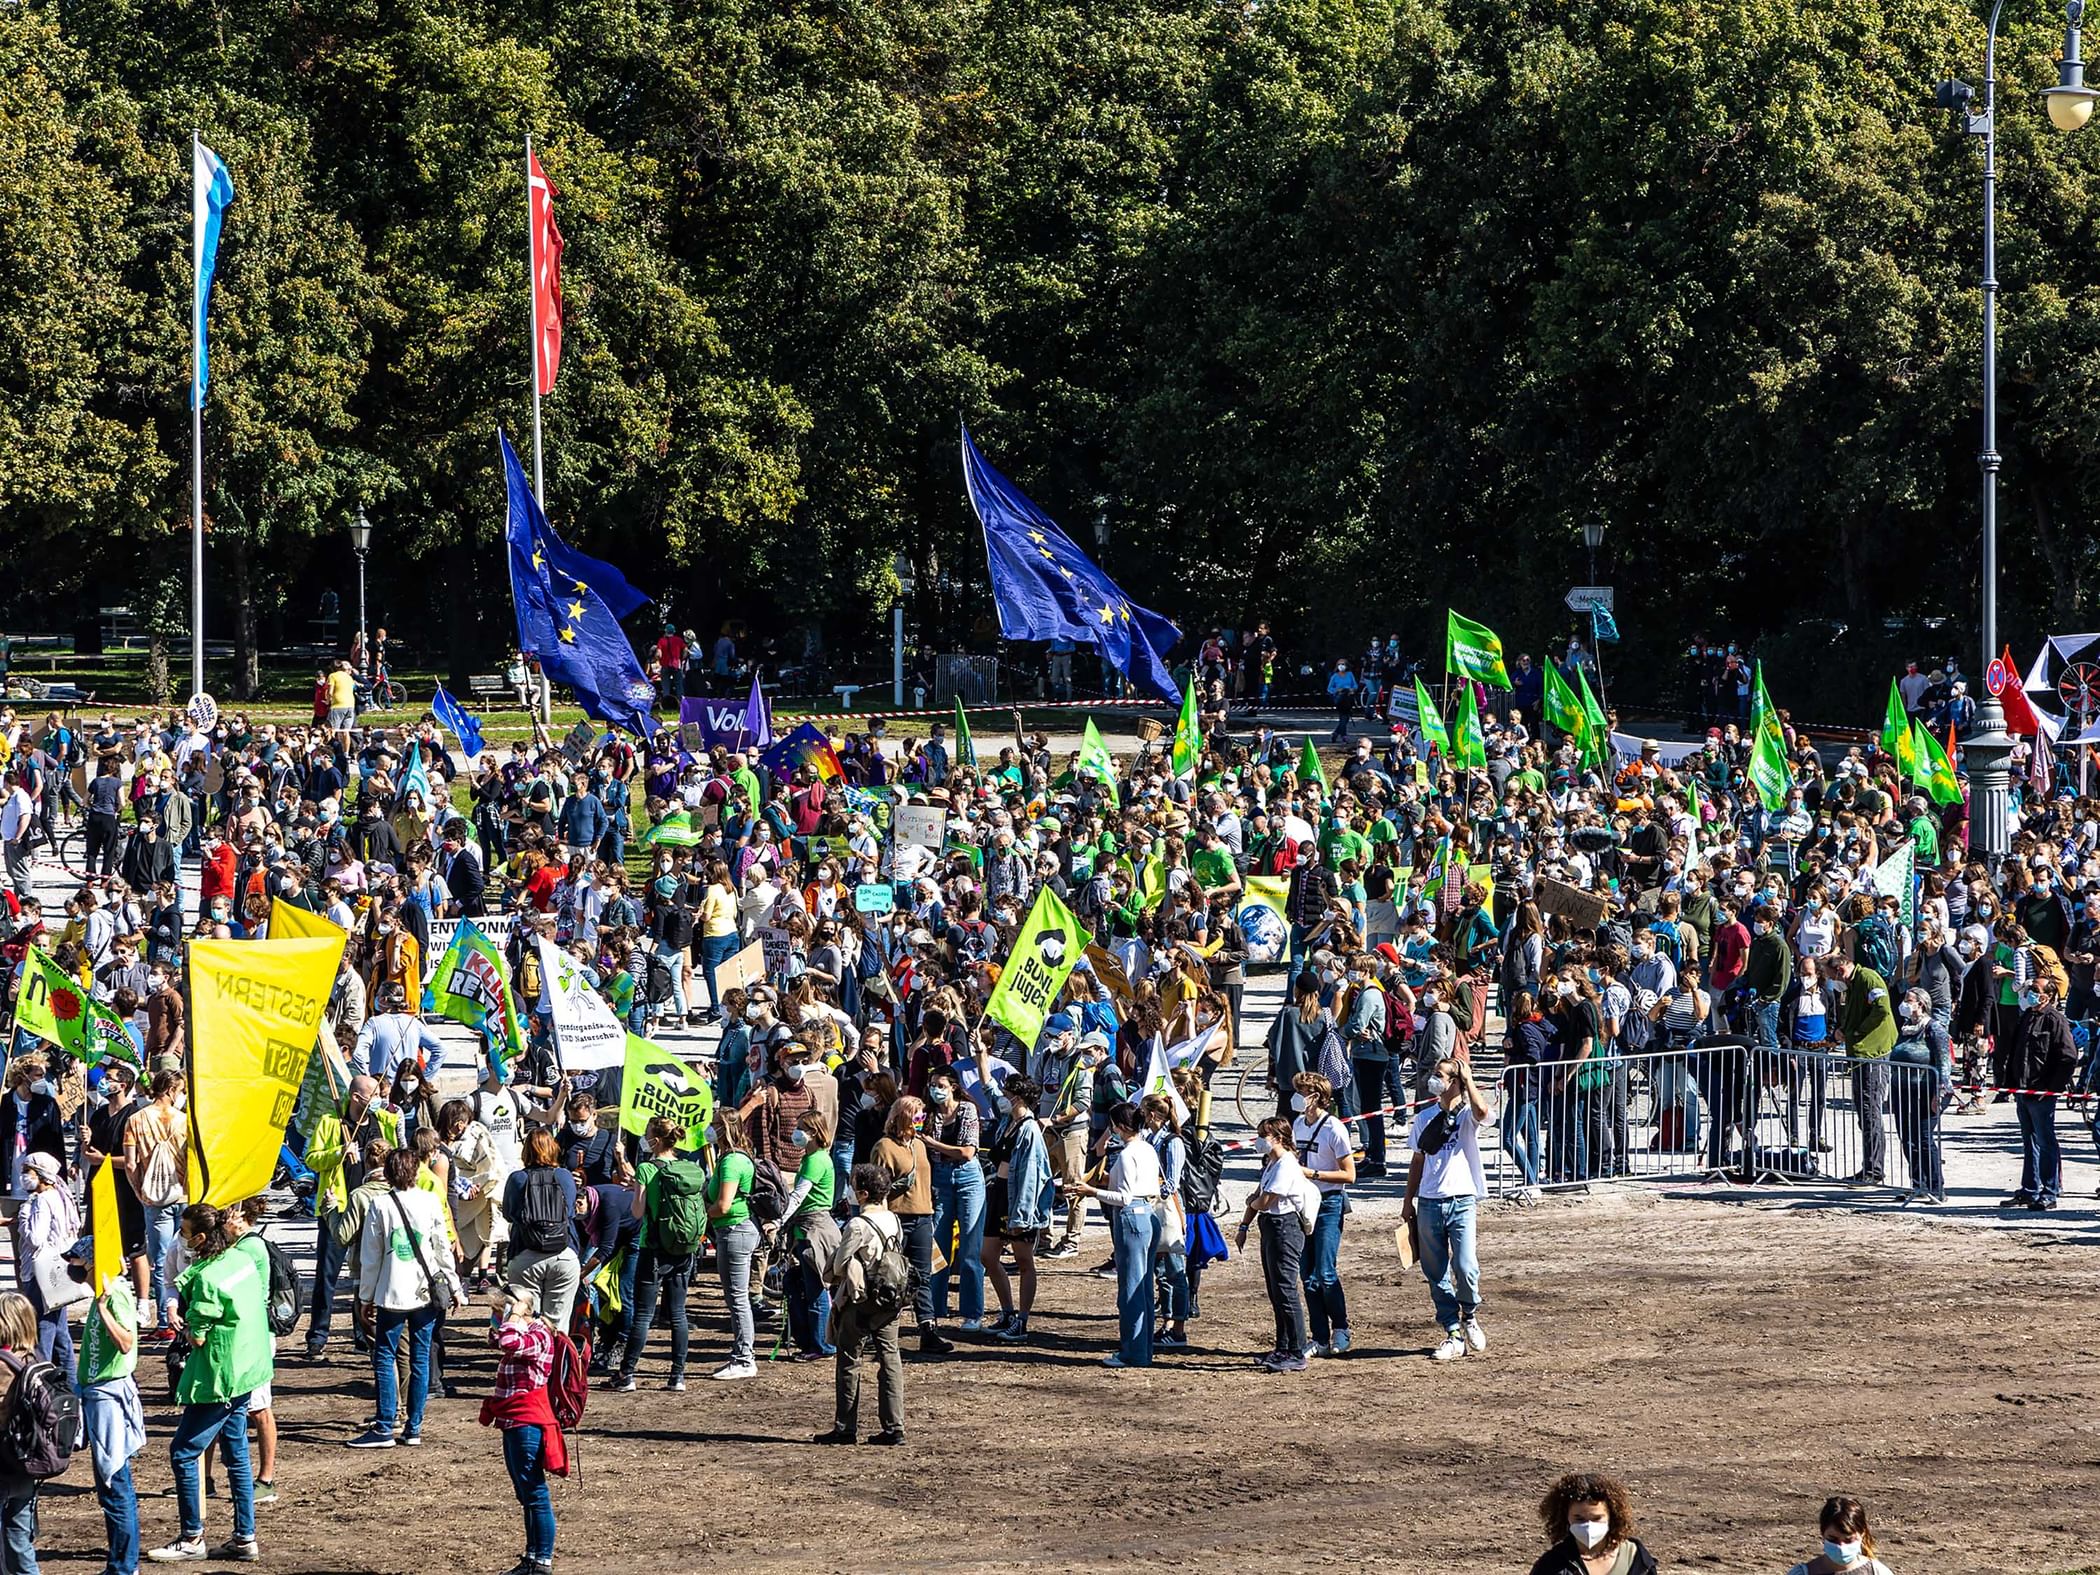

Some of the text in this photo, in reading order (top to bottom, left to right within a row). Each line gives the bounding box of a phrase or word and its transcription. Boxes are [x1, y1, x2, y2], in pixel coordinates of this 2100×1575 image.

[769, 956, 786, 972] HOT
[631, 1087, 706, 1128] jugend
[643, 1081, 700, 1115] BUND
[493, 1117, 511, 1125] BUND
